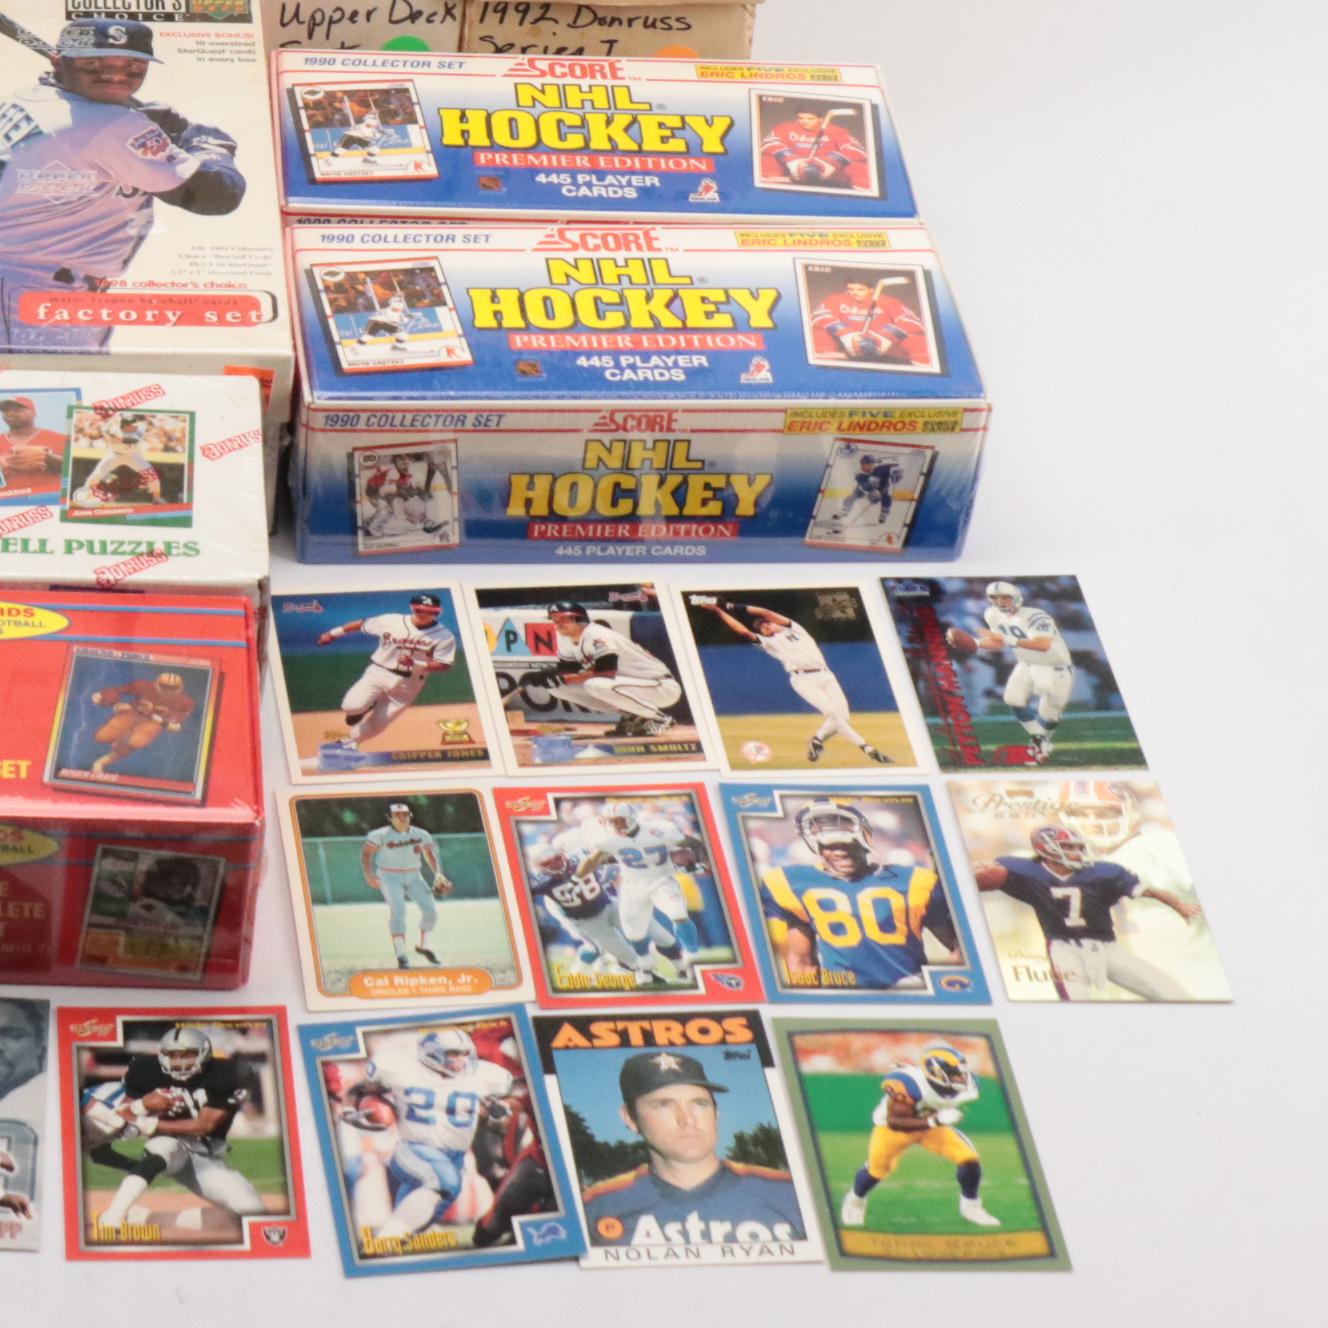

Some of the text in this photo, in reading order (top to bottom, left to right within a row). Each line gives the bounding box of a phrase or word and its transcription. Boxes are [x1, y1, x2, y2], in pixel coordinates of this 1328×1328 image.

[279, 1, 377, 40] Upper
[478, 1, 693, 32] 1992 Donruss
[302, 55, 467, 71] 1990 COLLECTOR SET
[503, 56, 626, 82] SCORE
[700, 71, 807, 80] ERIC LINDROS
[514, 82, 653, 112] NHL
[438, 105, 734, 156] HOCKEY
[478, 152, 709, 172] PREMIER EDITION
[535, 172, 661, 188] 445 PLAYER
[560, 185, 638, 199] CARDS
[203, 281, 248, 289] choice
[36, 303, 265, 327] factory set
[466, 285, 782, 332] HOCKEY
[582, 437, 706, 470] NHL
[506, 470, 773, 518] HOCKEY
[531, 523, 734, 539] PREMIER EDITION
[63, 538, 201, 557] PUZZLES
[617, 844, 671, 869] 27
[801, 887, 908, 948] 80
[1050, 886, 1088, 927] 7
[364, 974, 479, 988] Cal Ripken, Jr.
[551, 1016, 754, 1048] ASTROS
[403, 1086, 478, 1128] 20
[90, 1210, 161, 1242] Tim Brown
[604, 1243, 797, 1260] NOLAN RYAN
